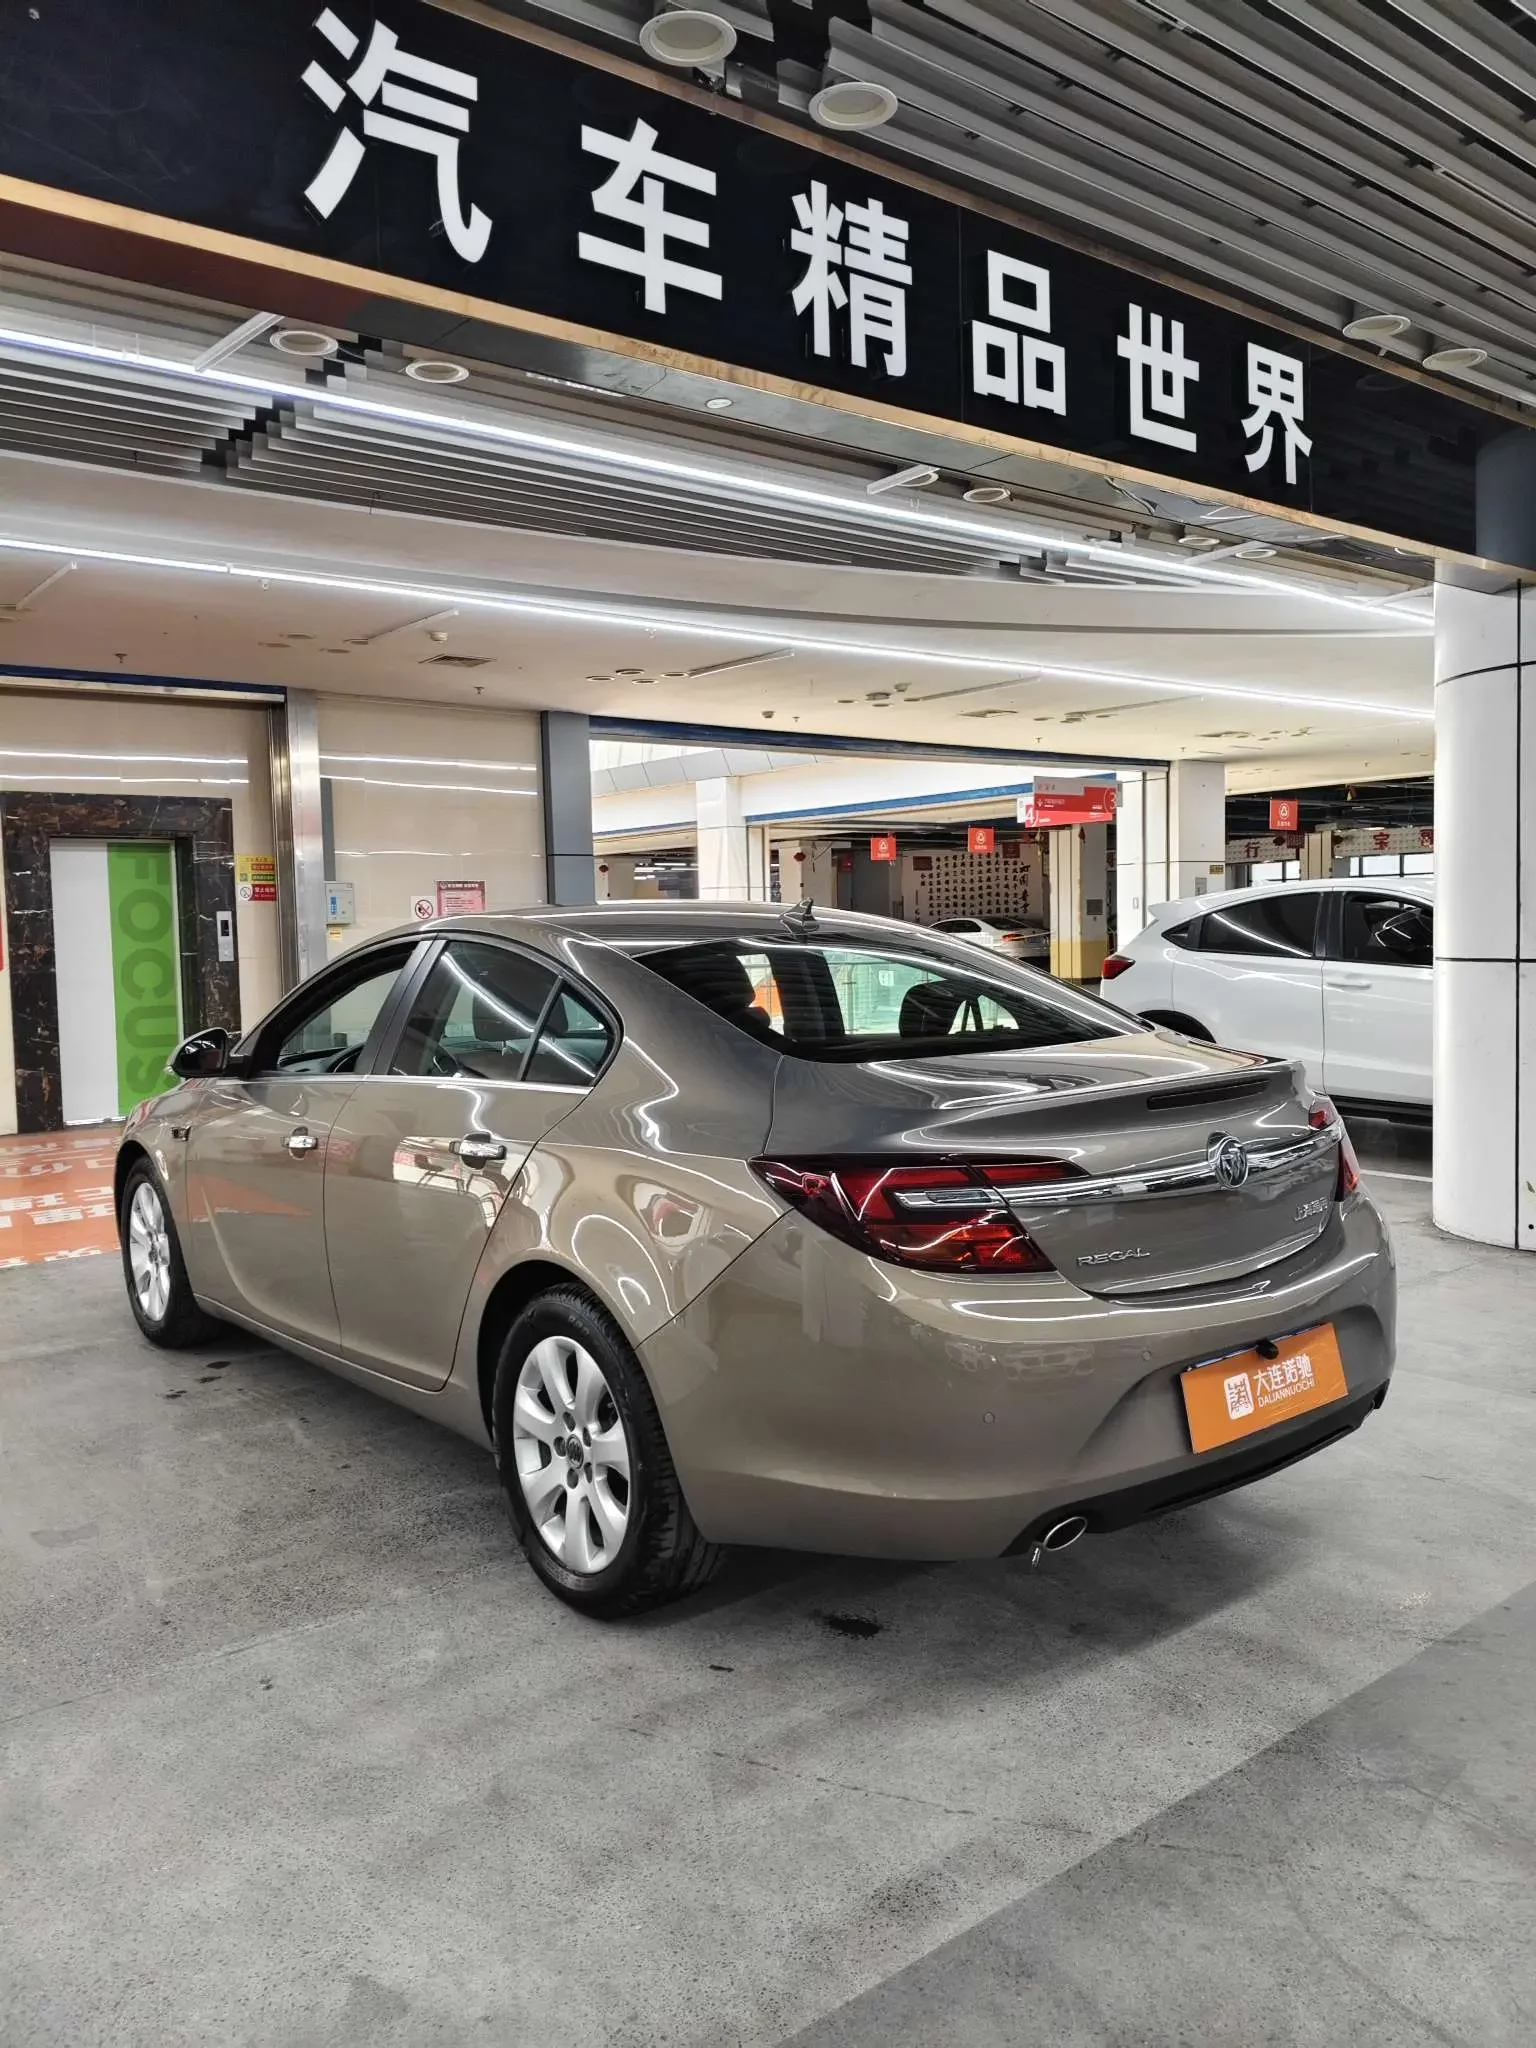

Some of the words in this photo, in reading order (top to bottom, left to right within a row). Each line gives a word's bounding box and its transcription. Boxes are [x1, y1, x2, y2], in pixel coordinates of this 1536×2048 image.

[301, 7, 1314, 485] 汽车精品世界
[116, 851, 181, 1095] FOCUS
[1076, 1247, 1151, 1267] REGAL
[1252, 1352, 1313, 1397] 大连诺驰
